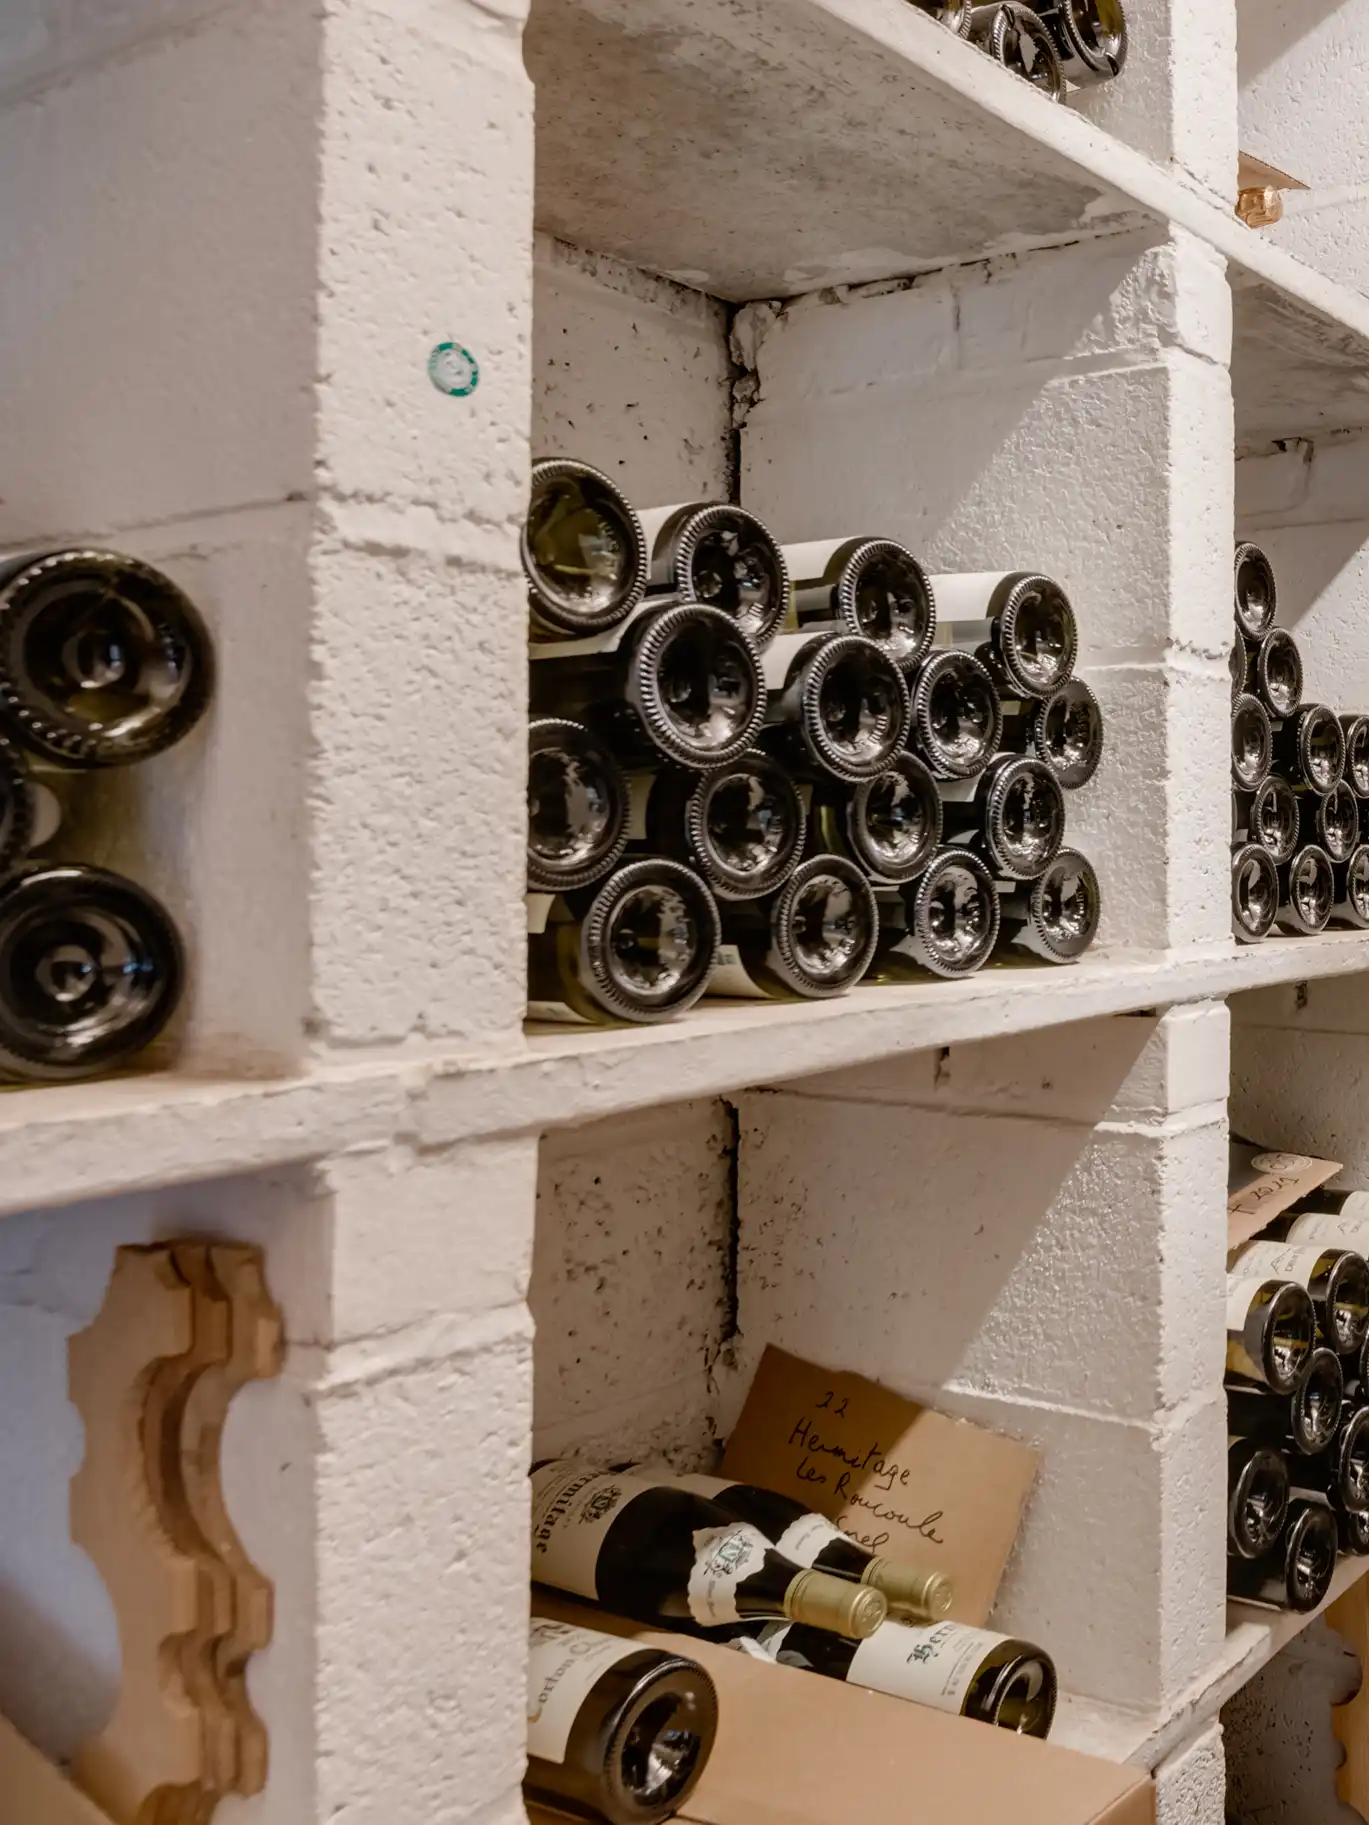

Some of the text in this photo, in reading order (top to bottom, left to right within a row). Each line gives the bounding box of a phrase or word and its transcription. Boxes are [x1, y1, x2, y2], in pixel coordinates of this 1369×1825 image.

[815, 1390, 850, 1419] 22
[788, 1416, 910, 1491] Hermitage
[534, 1471, 614, 1554] ermitage
